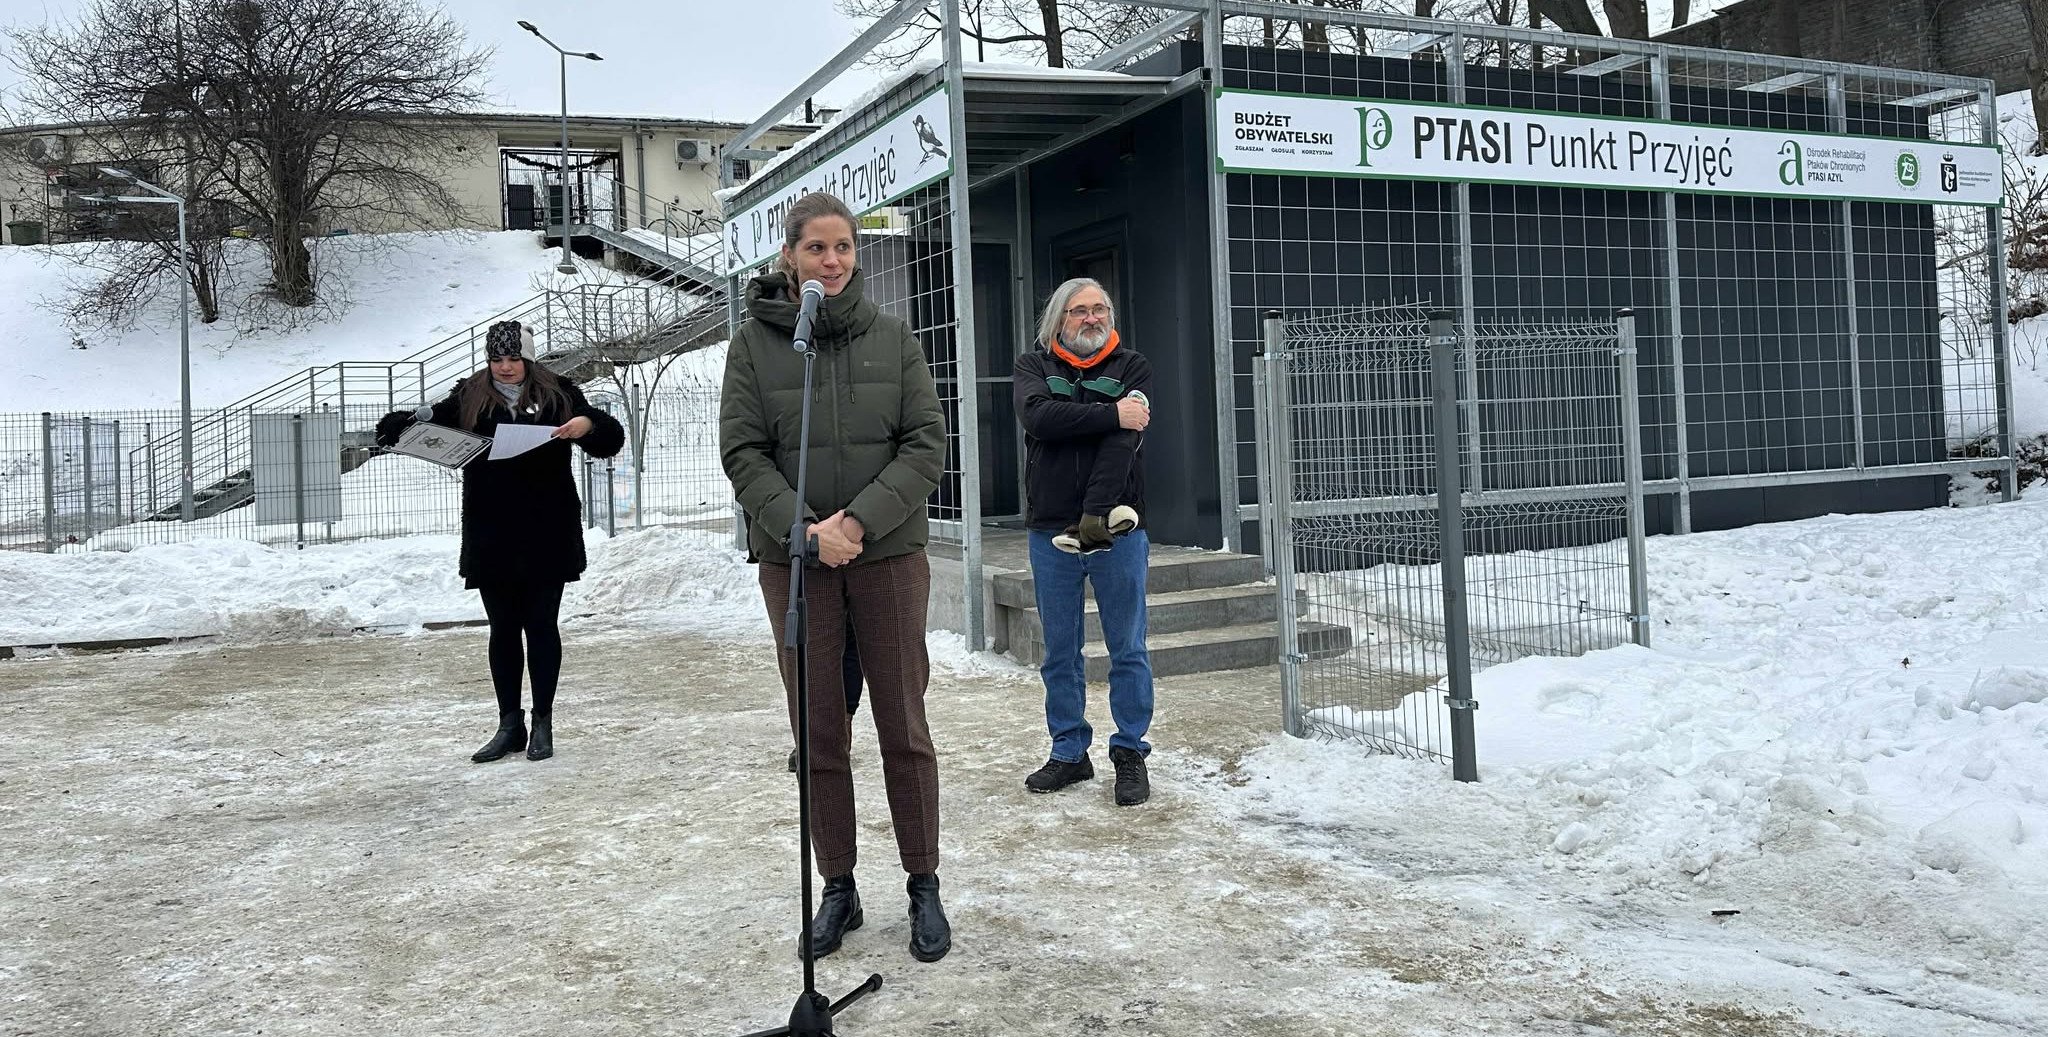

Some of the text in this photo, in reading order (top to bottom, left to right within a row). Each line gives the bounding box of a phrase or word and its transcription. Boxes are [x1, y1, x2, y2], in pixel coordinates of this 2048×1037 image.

[1234, 111, 1291, 127] BUDŻET
[1235, 127, 1333, 145] OBYWATELSKI
[1271, 147, 1296, 155] GŁOSUJĘ
[1413, 115, 1733, 186] PTASI Punkt Przyjęć
[1806, 147, 1866, 161] Ośrodek Rehabilitacji
[841, 135, 896, 207] Przyjęć
[1807, 160, 1866, 173] Ptaków Chronionych
[1808, 172, 1844, 182] PTASI AZYL
